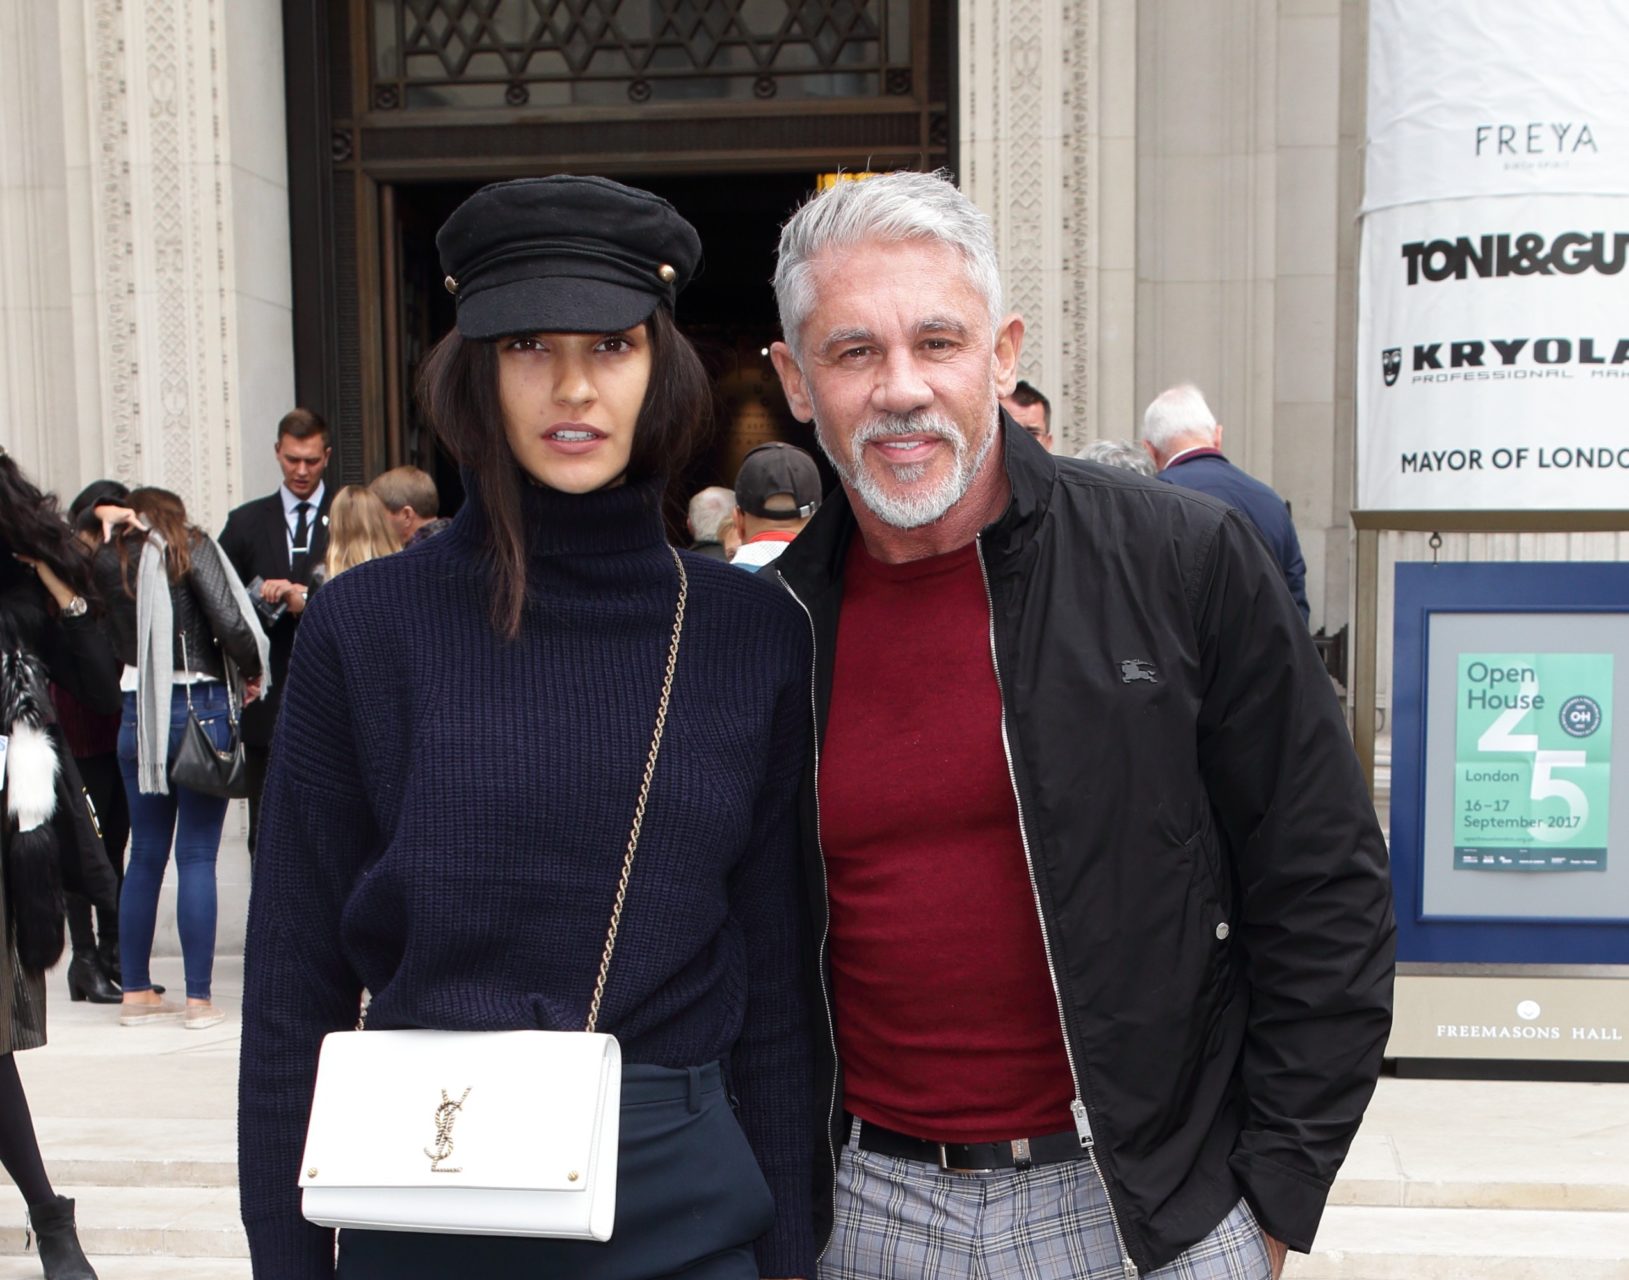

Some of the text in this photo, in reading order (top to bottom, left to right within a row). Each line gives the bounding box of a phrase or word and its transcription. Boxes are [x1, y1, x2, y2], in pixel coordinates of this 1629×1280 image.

[1475, 121, 1599, 157] FREYA
[1401, 231, 1629, 286] TONI&GU
[1411, 337, 1629, 371] KRYOLA
[1411, 368, 1574, 384] PROFESSIONAL
[1401, 446, 1629, 473] MAYOR OF LONDO
[1467, 661, 1535, 689] Open
[1467, 688, 1545, 710] House
[1465, 769, 1519, 783] London
[1463, 815, 1581, 831] September 2017
[1436, 1025, 1623, 1041] FREEMASONS HALL
